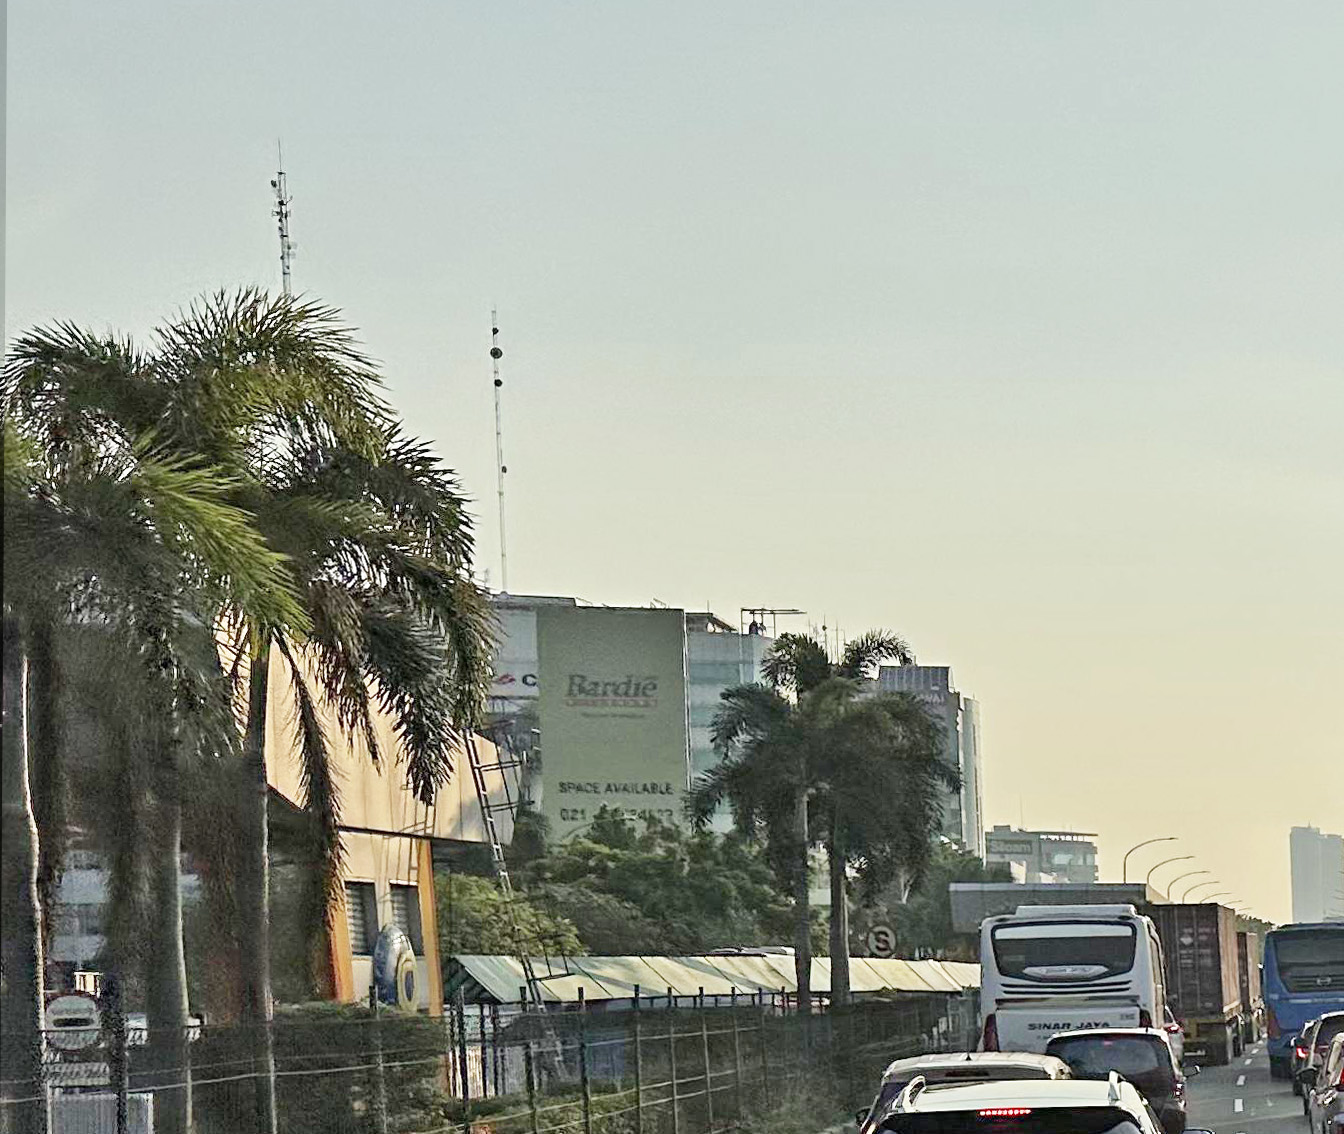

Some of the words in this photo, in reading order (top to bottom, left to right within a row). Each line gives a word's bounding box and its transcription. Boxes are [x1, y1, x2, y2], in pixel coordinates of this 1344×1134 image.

[559, 782, 601, 794] SPACE
[604, 782, 674, 795] AVAILABLE
[1028, 1022, 1071, 1031] SINAR
[1074, 1021, 1110, 1031] JAYA
